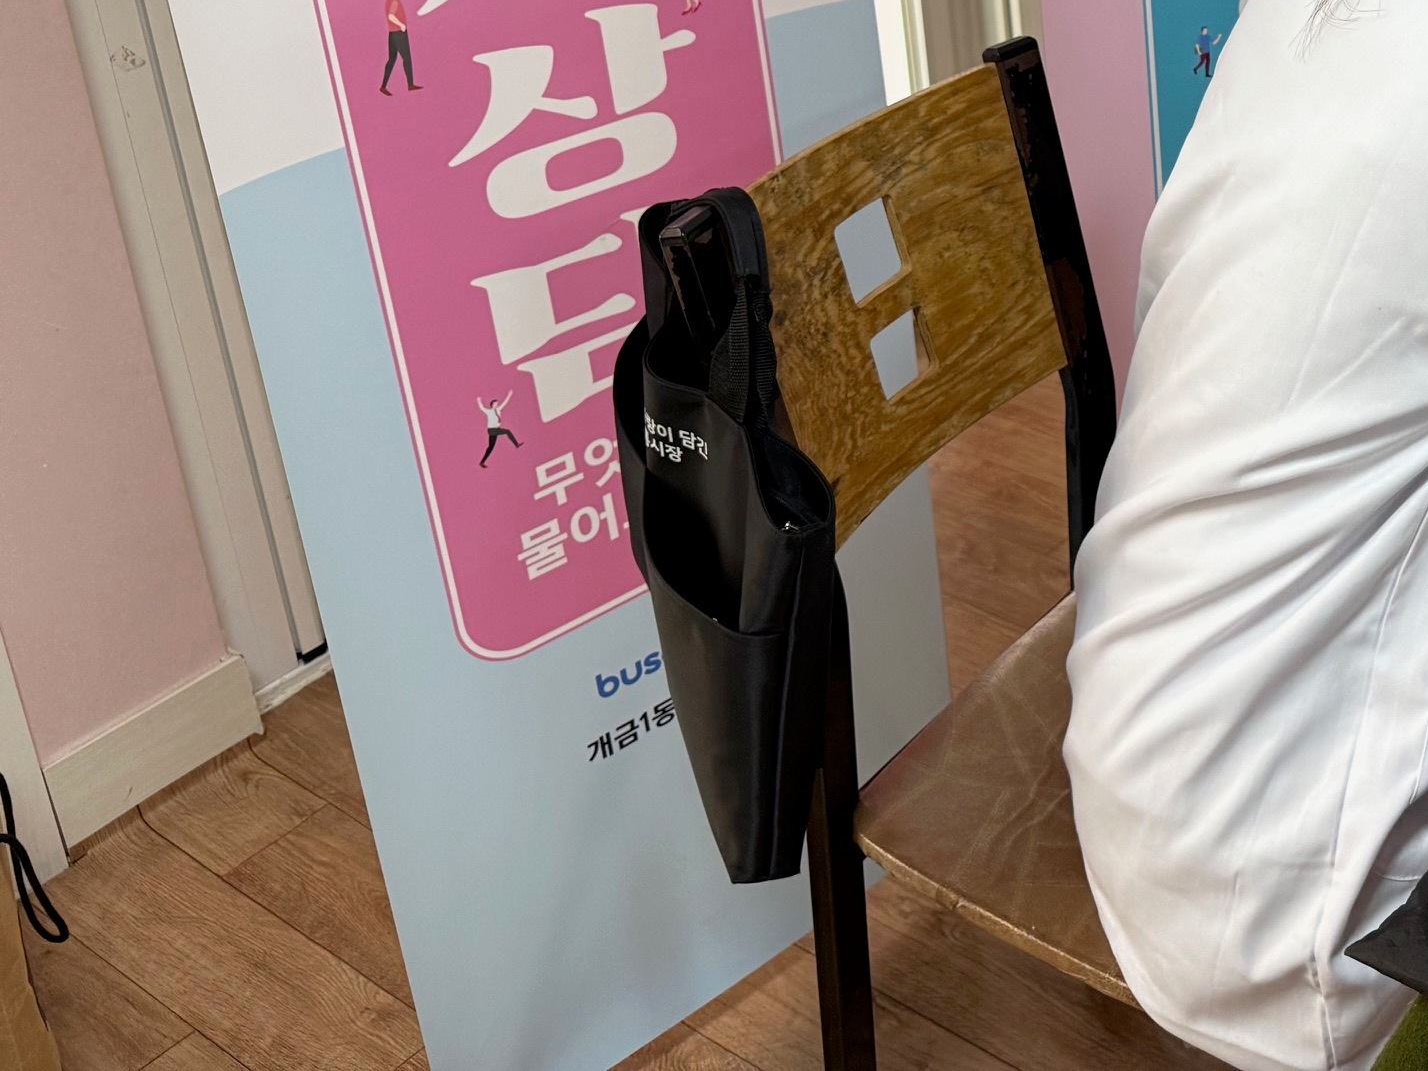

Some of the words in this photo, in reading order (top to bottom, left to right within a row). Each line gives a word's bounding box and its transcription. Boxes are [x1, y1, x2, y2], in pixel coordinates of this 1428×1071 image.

[645, 429, 683, 463] 시장
[679, 429, 708, 461] 담긴
[517, 492, 629, 581] 물어
[587, 698, 676, 761] 개금1동
